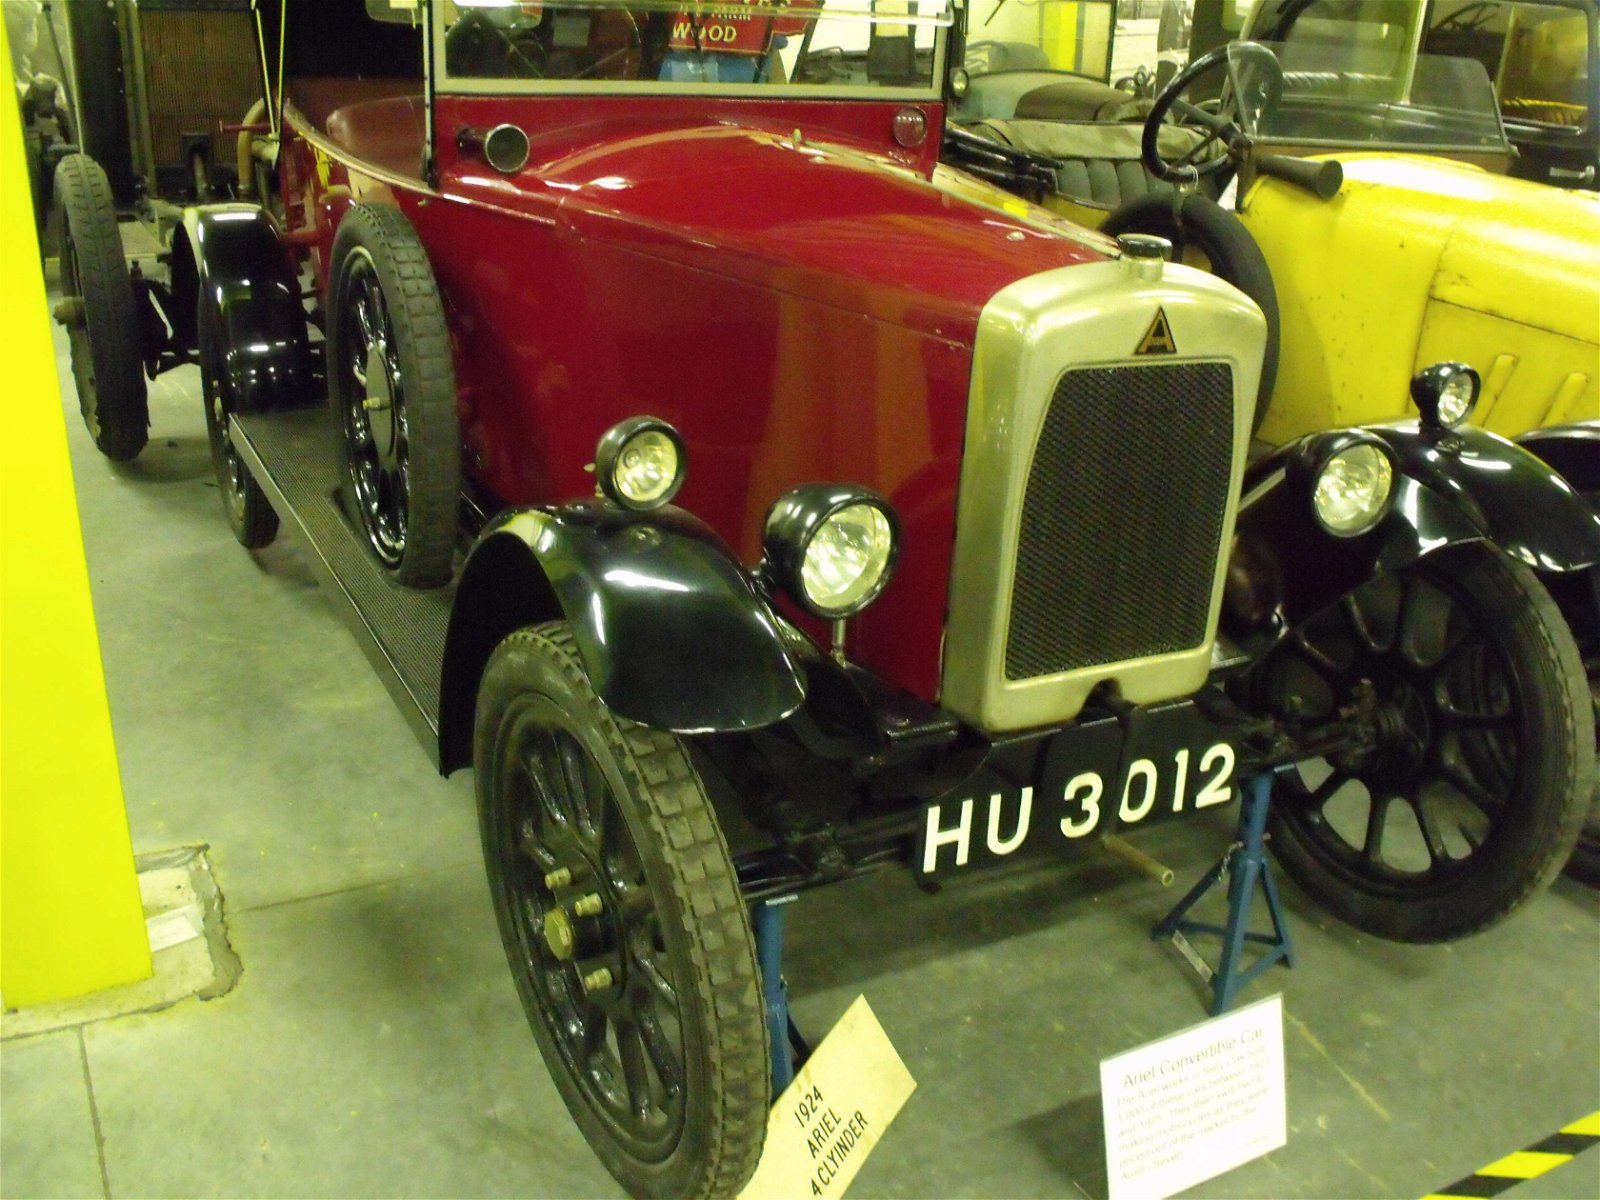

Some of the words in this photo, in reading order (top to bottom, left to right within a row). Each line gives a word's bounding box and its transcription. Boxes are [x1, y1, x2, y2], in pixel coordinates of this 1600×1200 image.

[923, 786, 1034, 873] HU
[1060, 743, 1235, 839] 3012
[1123, 1065, 1156, 1089] Ariel
[1160, 1037, 1236, 1076] Convertible
[1241, 1027, 1263, 1044] Car
[794, 1085, 824, 1128] 1924
[806, 1107, 842, 1159] ARIEL
